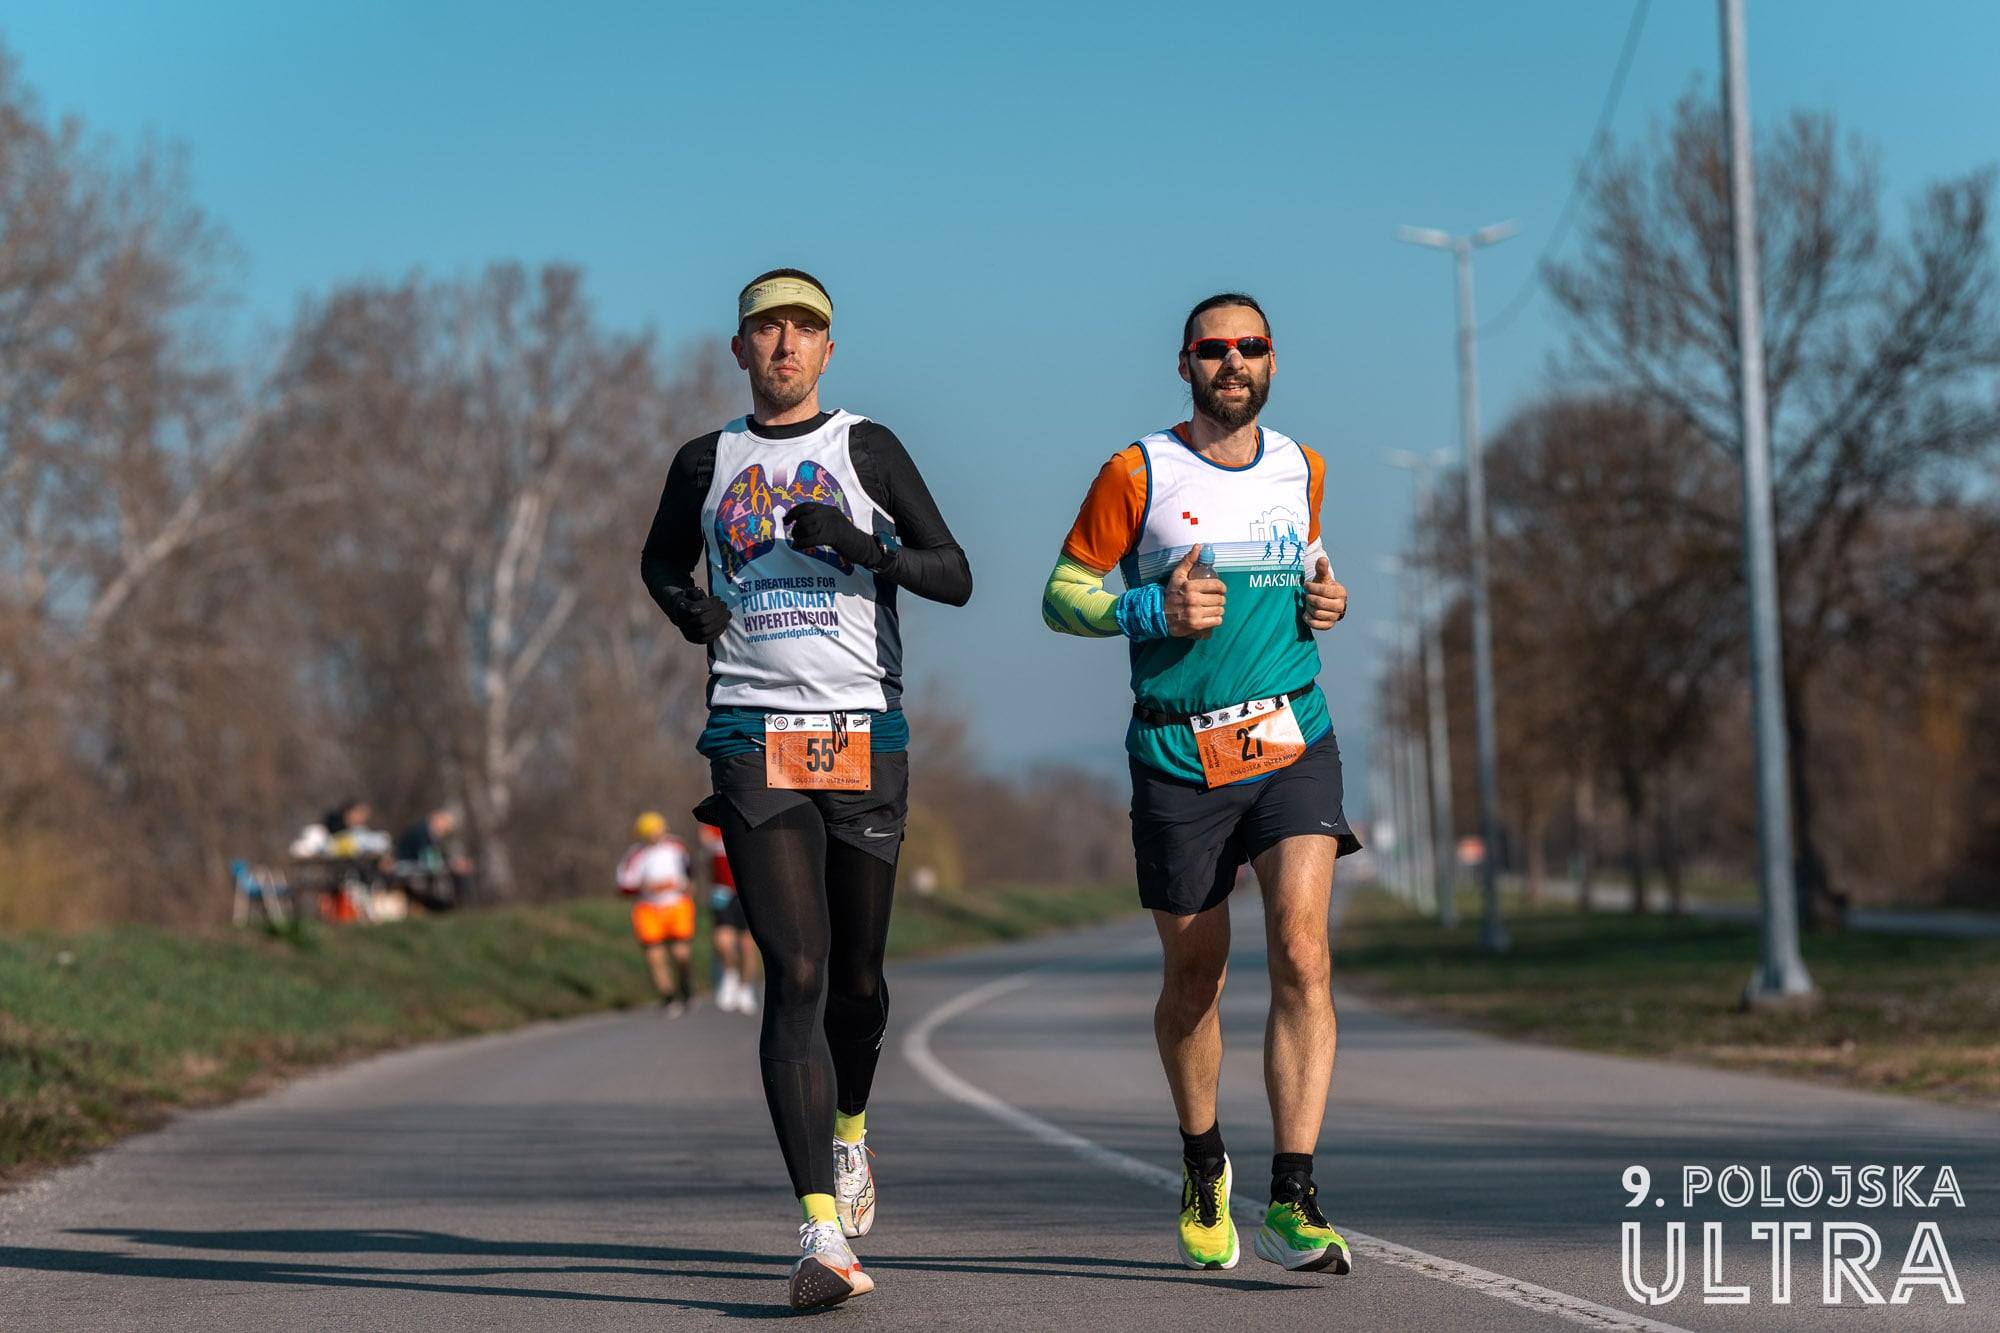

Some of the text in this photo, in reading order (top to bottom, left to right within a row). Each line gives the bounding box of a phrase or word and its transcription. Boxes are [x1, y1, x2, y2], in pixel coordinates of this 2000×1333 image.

[754, 577, 814, 591] BREATHLESS
[816, 576, 836, 589] FOR
[740, 590, 836, 614] PULMONARY
[743, 610, 839, 633] HYPERTENSION
[806, 737, 835, 773] 55
